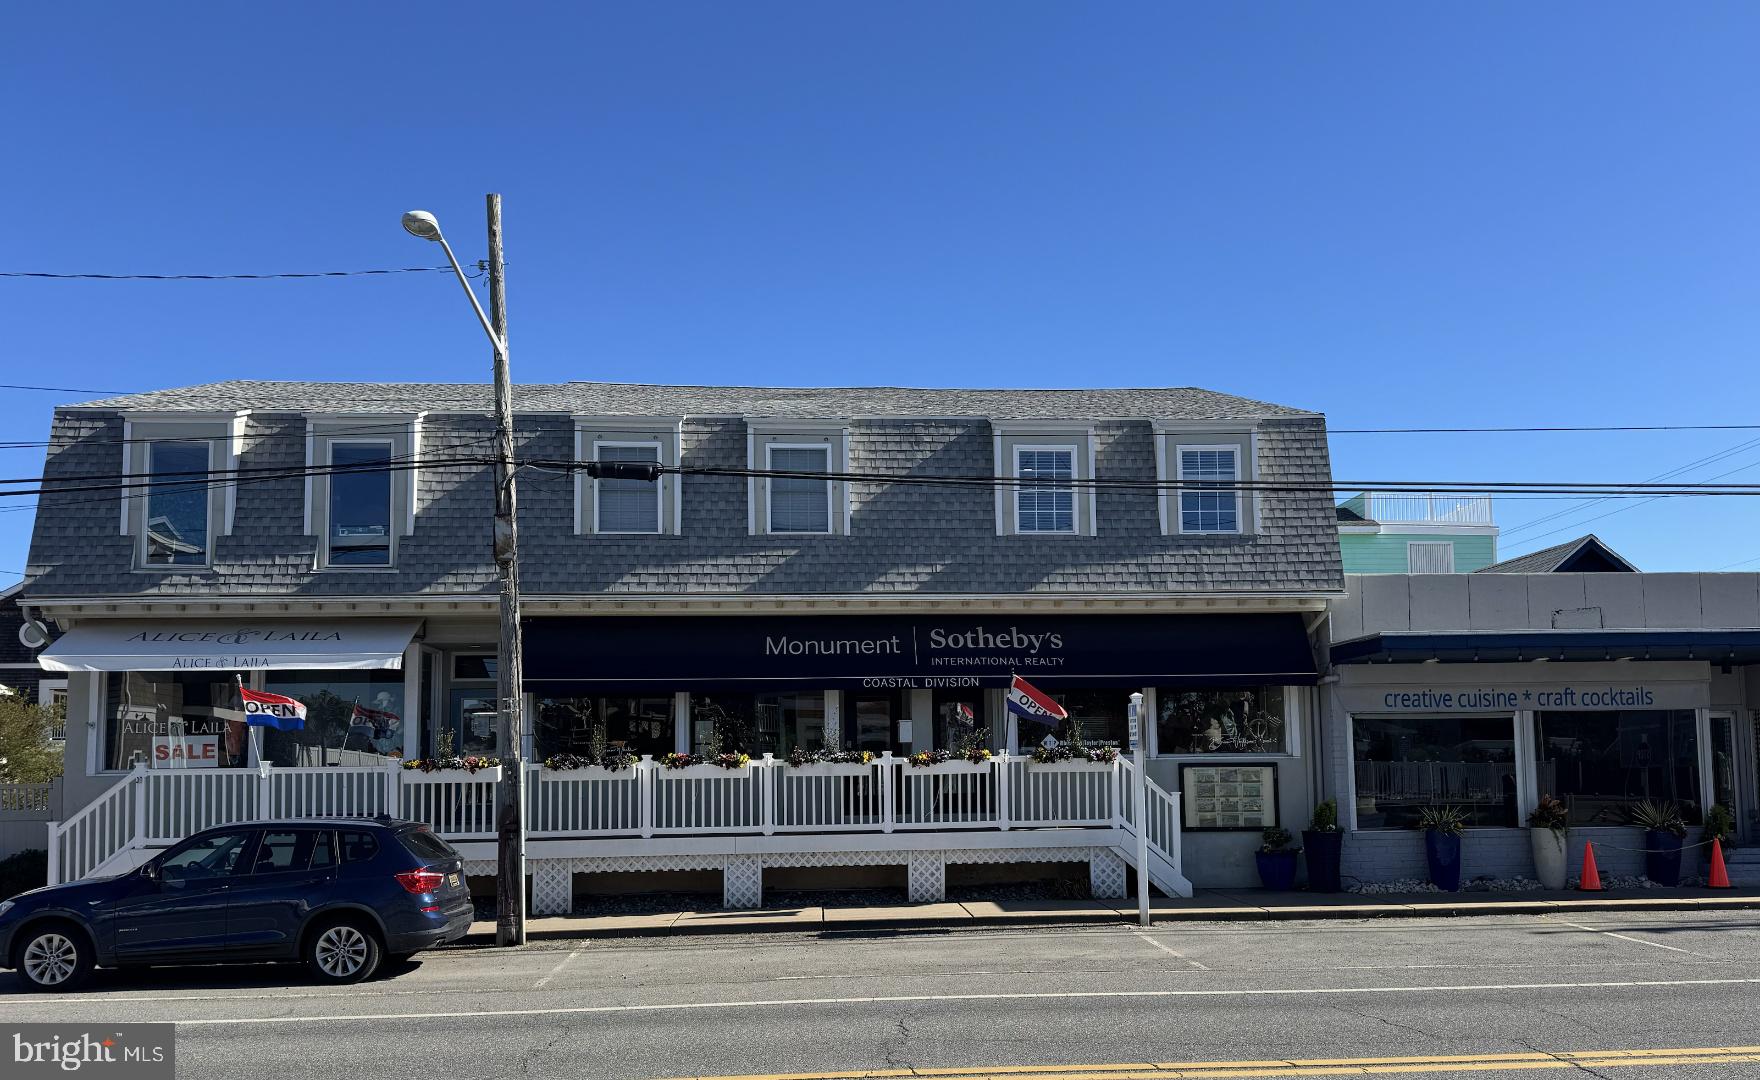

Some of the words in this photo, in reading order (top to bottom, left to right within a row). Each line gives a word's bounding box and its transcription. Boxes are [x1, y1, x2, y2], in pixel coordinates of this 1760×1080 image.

[127, 631, 217, 642] ALICE
[217, 628, 261, 645] &
[263, 631, 342, 641] LAILA
[930, 626, 1063, 653] Sotheby's
[765, 635, 901, 655] Monument
[172, 657, 211, 669] ALICE
[216, 656, 228, 668] &
[233, 657, 270, 668] LAILA
[931, 657, 1022, 666] INTERNATIONAL
[1025, 657, 1065, 666] REALTY
[863, 678, 918, 688] COASTAL
[925, 677, 980, 687] DIVISION
[1384, 689, 1452, 708] creative
[1457, 689, 1518, 708] cuisine
[1537, 687, 1577, 707] craft
[1581, 686, 1654, 707] cocktails
[245, 701, 296, 717] OPEN
[123, 721, 166, 734] ALICE
[191, 721, 233, 734] LAILA
[155, 743, 215, 760] SALE
